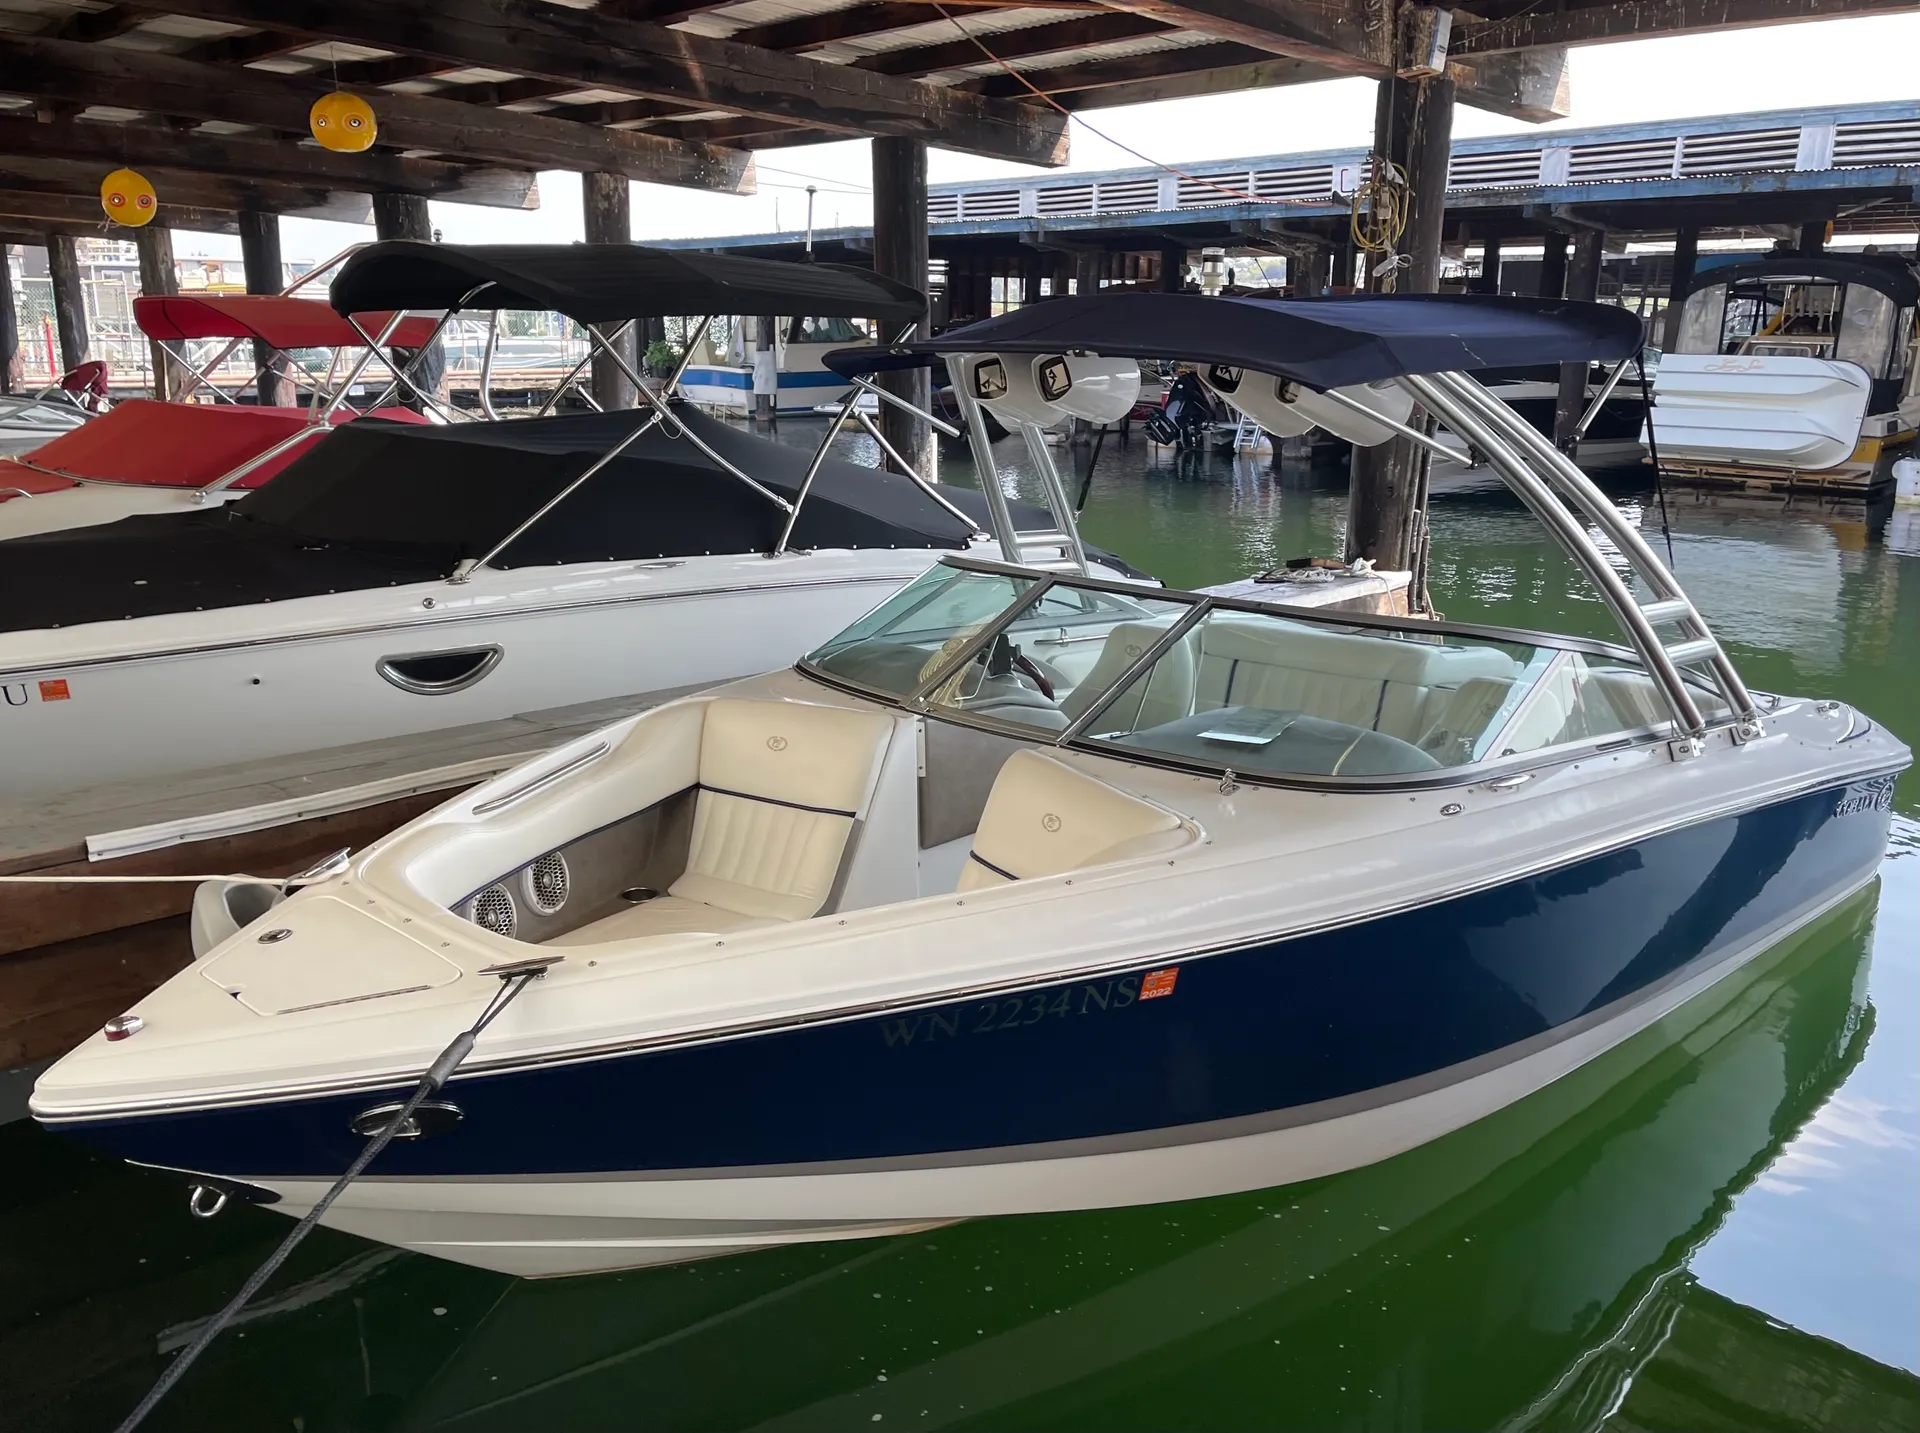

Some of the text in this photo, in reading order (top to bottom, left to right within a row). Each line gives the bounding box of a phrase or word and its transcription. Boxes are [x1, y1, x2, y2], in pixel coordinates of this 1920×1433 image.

[878, 976, 1139, 1048] WN 2234 NS
[1140, 988, 1172, 1000] 2022
